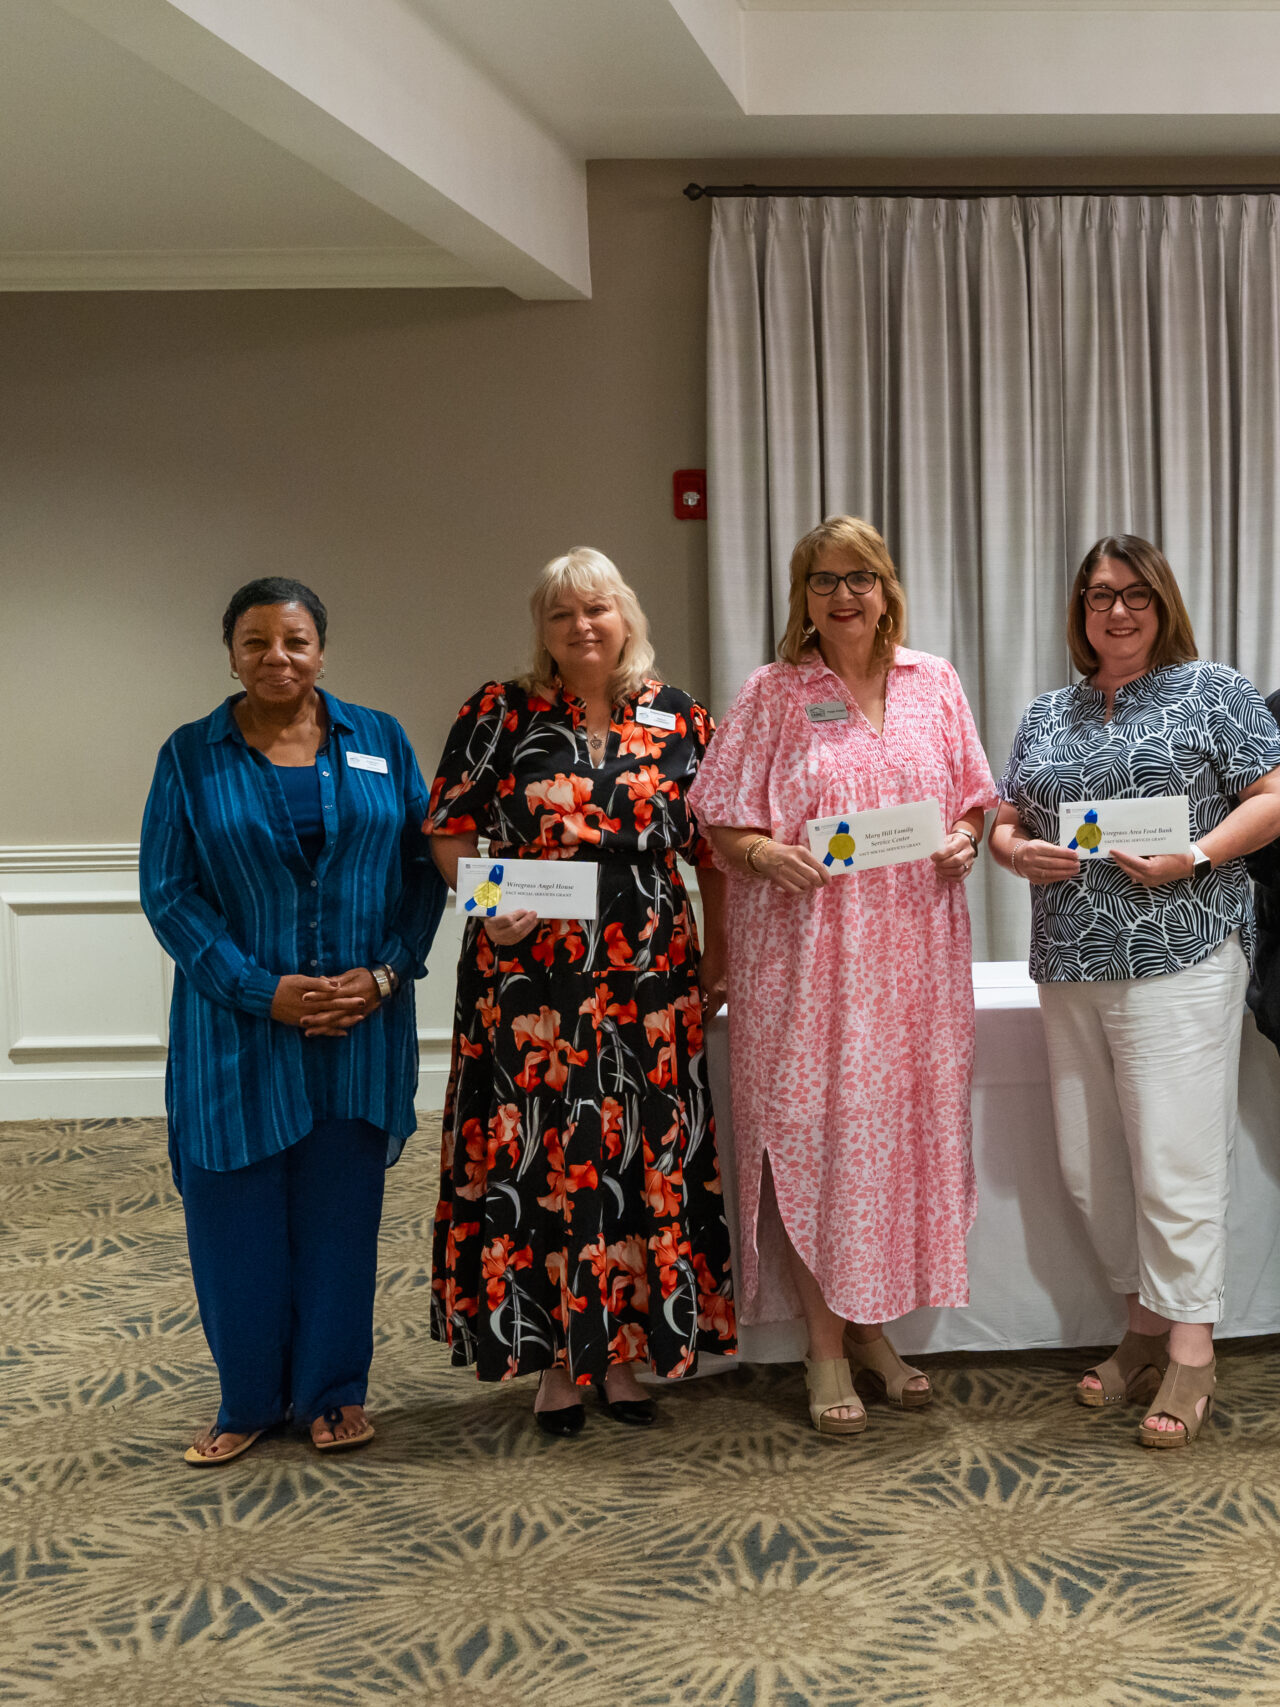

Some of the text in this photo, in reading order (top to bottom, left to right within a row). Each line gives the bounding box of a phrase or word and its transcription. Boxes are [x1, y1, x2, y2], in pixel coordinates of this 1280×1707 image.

[864, 832, 881, 840] Mary
[894, 826, 913, 836] Family
[871, 836, 910, 847] Service Center
[507, 882, 536, 890] Wiregrass
